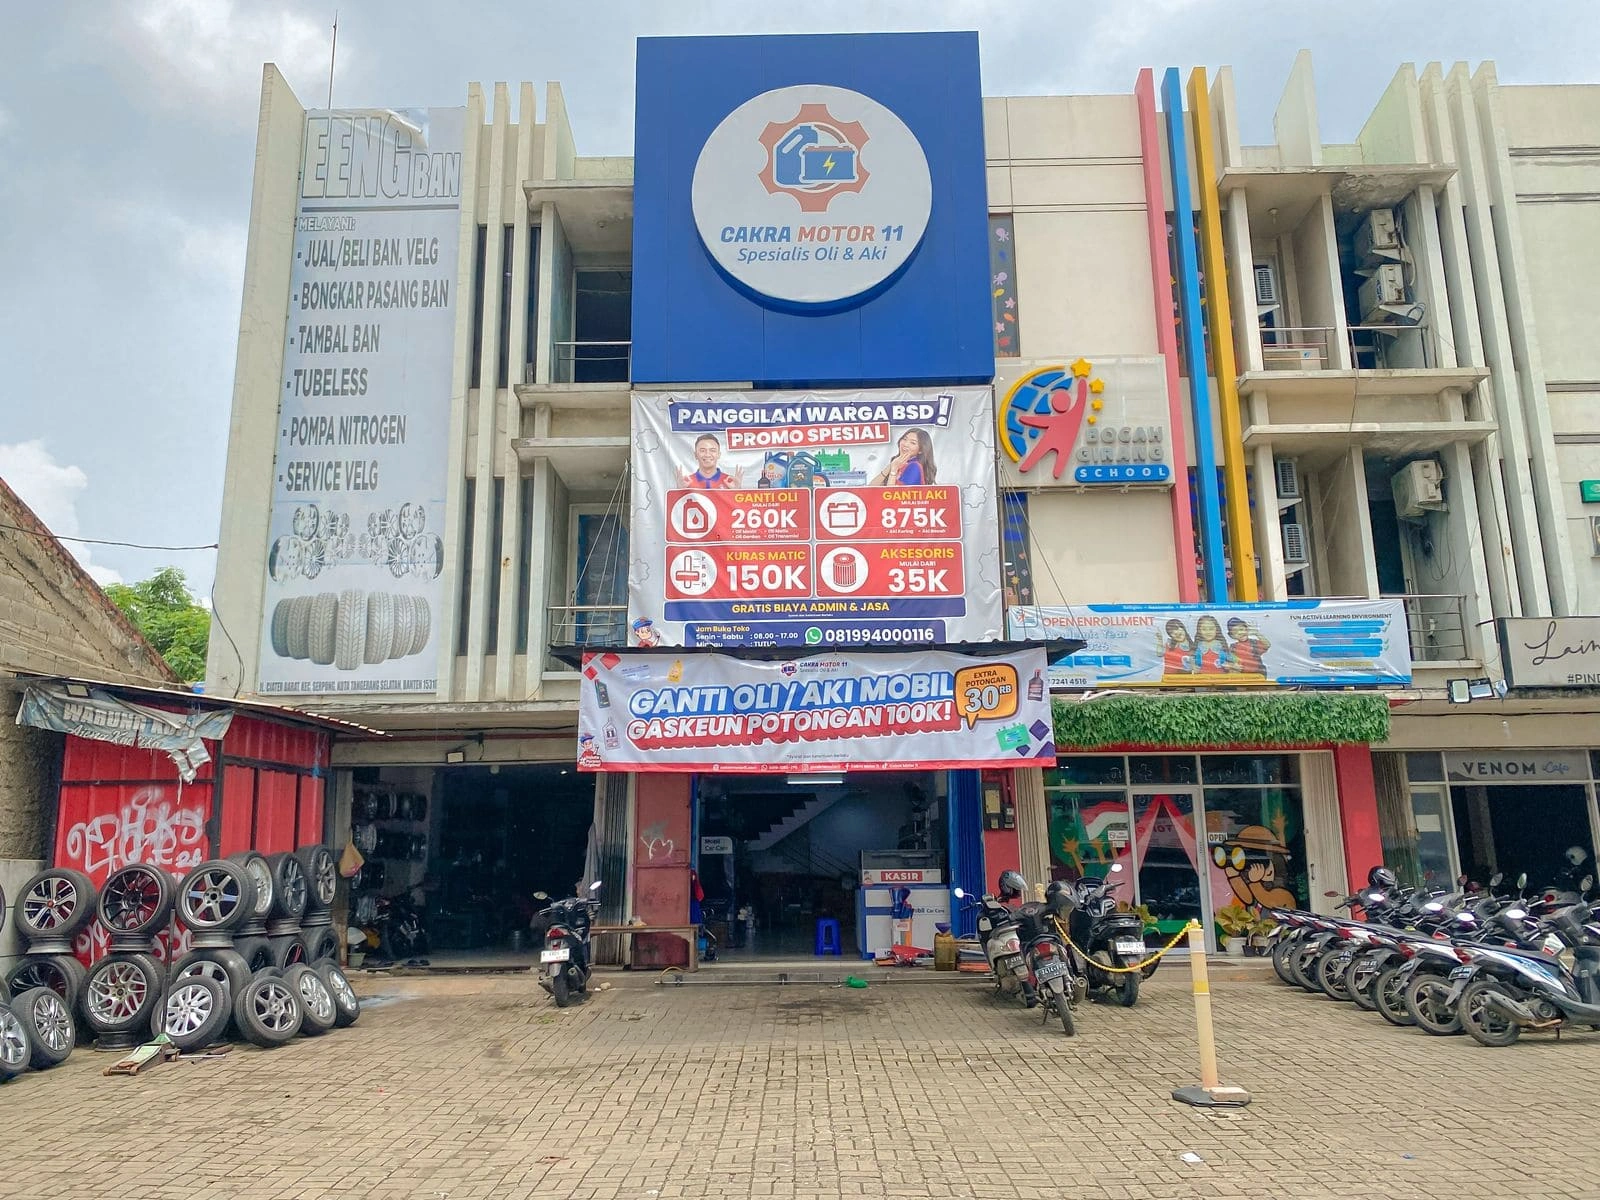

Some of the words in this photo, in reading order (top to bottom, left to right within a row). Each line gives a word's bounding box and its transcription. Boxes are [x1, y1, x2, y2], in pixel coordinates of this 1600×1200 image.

[301, 114, 413, 199] EENG
[412, 152, 461, 198] BAN
[721, 226, 791, 243] CAKRA
[797, 225, 875, 242] MOTOR
[881, 225, 903, 241] 11
[304, 236, 370, 271] JUAL/BELI
[406, 238, 438, 265] VELG
[737, 248, 809, 264] Spesialis
[815, 247, 838, 261] Oli
[843, 247, 854, 261] &
[859, 246, 887, 260] Aki
[301, 281, 363, 310] BONGKAR
[367, 280, 418, 309] PASANG
[422, 280, 449, 308] BAN
[299, 325, 349, 353] TAMBAL
[352, 324, 380, 352] BAN
[294, 368, 368, 396] TUBELESS
[678, 408, 801, 424] PANGGILAN
[806, 404, 890, 421] WARGA
[290, 416, 334, 446] POMPA
[338, 415, 406, 444] NITROGEN
[731, 431, 803, 447] PROMO
[808, 425, 885, 442] SPESIAL
[286, 461, 340, 491] SERVICE
[345, 460, 379, 490] VELG
[1080, 467, 1166, 478] SCHOOL
[734, 493, 775, 503] GANTI
[778, 492, 798, 502] OLI
[882, 491, 923, 500] GANTI
[925, 490, 947, 500] AKI
[731, 509, 798, 529] 260K
[881, 508, 948, 528] 875K
[727, 552, 766, 561] KURAS
[768, 551, 806, 560] MATIC
[880, 549, 954, 559] AKSESORIS
[727, 565, 807, 591] 150K
[888, 568, 948, 593] 35K
[732, 604, 772, 613] GRATIS
[774, 603, 808, 613] BIAYA
[809, 603, 847, 612] ADMIN
[849, 603, 858, 612] &
[860, 602, 889, 611] JASA
[1043, 617, 1075, 627] OPEN
[1079, 616, 1155, 627] ENROLLMENT
[825, 628, 935, 642] 081994000116
[966, 676, 1006, 687] POTONGAN
[974, 670, 997, 679] EXTRA
[631, 685, 729, 715] GANTI
[733, 683, 779, 711] OLI
[801, 678, 853, 706] AKI
[860, 672, 954, 703] MOBIL
[629, 715, 744, 740] GASKEUN
[747, 706, 883, 736] POTONGAN
[886, 701, 951, 724] 100K!
[1463, 762, 1536, 775] VENOM
[1209, 833, 1226, 841] OPEN
[885, 872, 919, 881] KASIR
